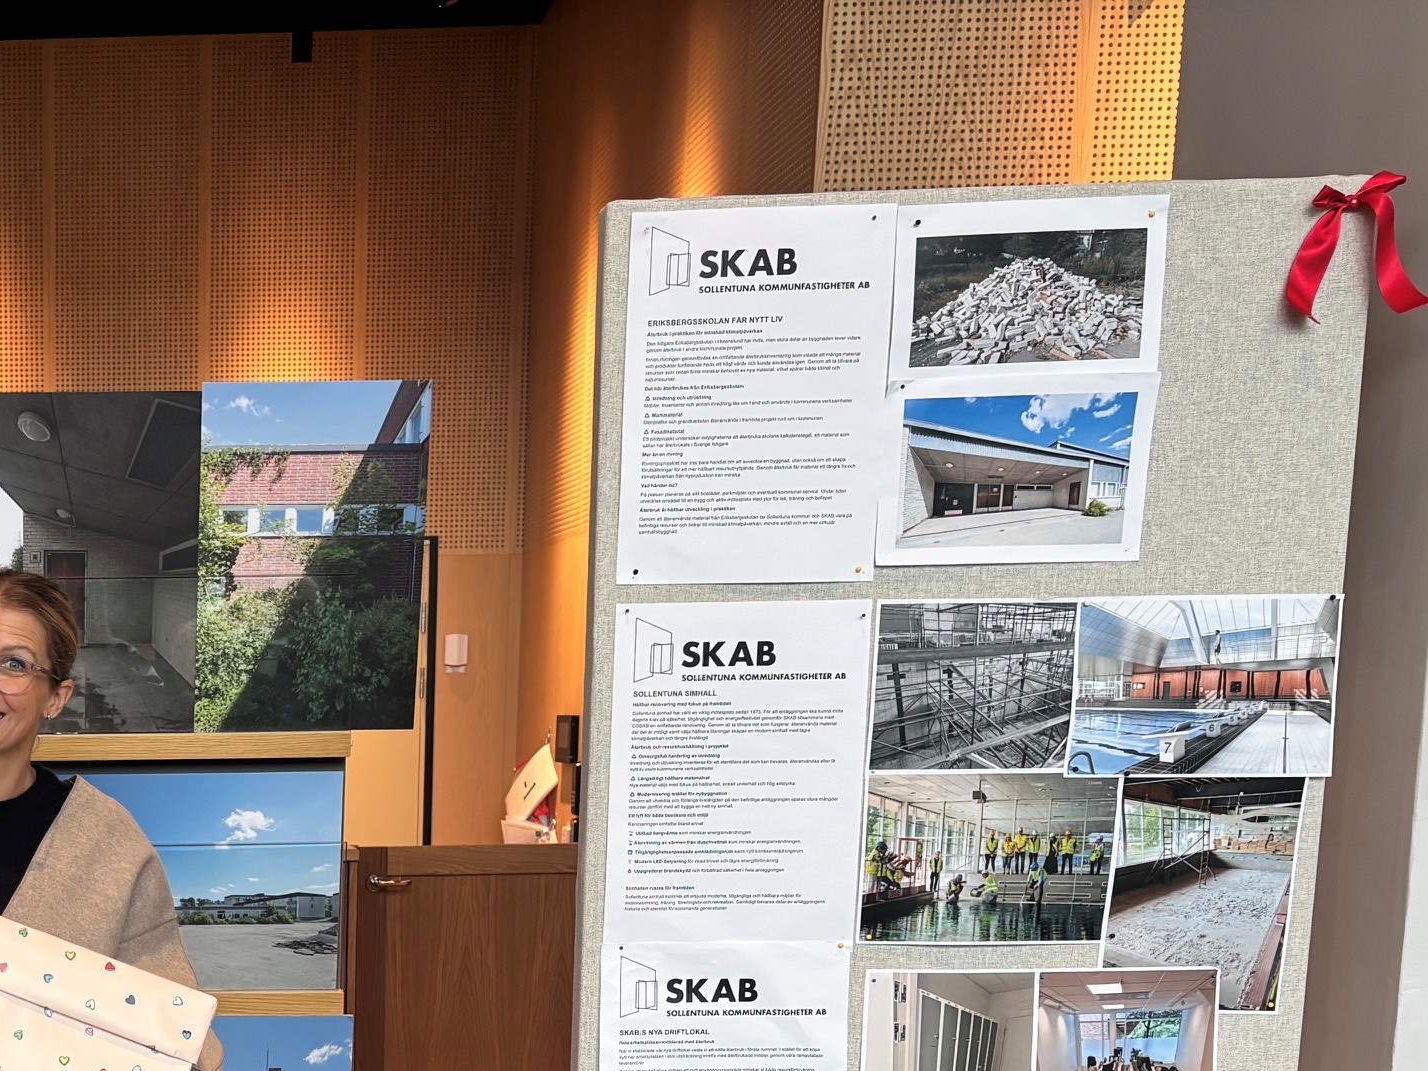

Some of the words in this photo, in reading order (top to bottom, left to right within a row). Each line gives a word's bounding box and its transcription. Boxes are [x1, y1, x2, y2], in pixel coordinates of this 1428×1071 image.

[699, 248, 798, 279] SKAB
[699, 284, 756, 294] SOLLENTUNA
[759, 282, 855, 292] KOMMUNFASTIGHETER
[858, 281, 870, 289] AB
[647, 317, 730, 327] ERIKSBERGSSKOLAN
[749, 316, 769, 324] NYTT
[771, 315, 783, 323] LIV
[681, 641, 776, 668] SKAB
[681, 674, 736, 682] SOLLENTUNA
[739, 672, 832, 681] KOMMUNFASTIGHETER
[834, 672, 846, 680] AB
[633, 690, 683, 698] SOLLENTUNA
[685, 689, 717, 697] SIMHALL
[1209, 724, 1215, 732] 6
[1164, 742, 1172, 754] 7
[666, 978, 758, 1004] SKAB
[666, 1009, 720, 1017] SOLLENTUNA
[722, 1008, 813, 1016] KOMMUNFASTIGHETER
[815, 1008, 827, 1016] AB
